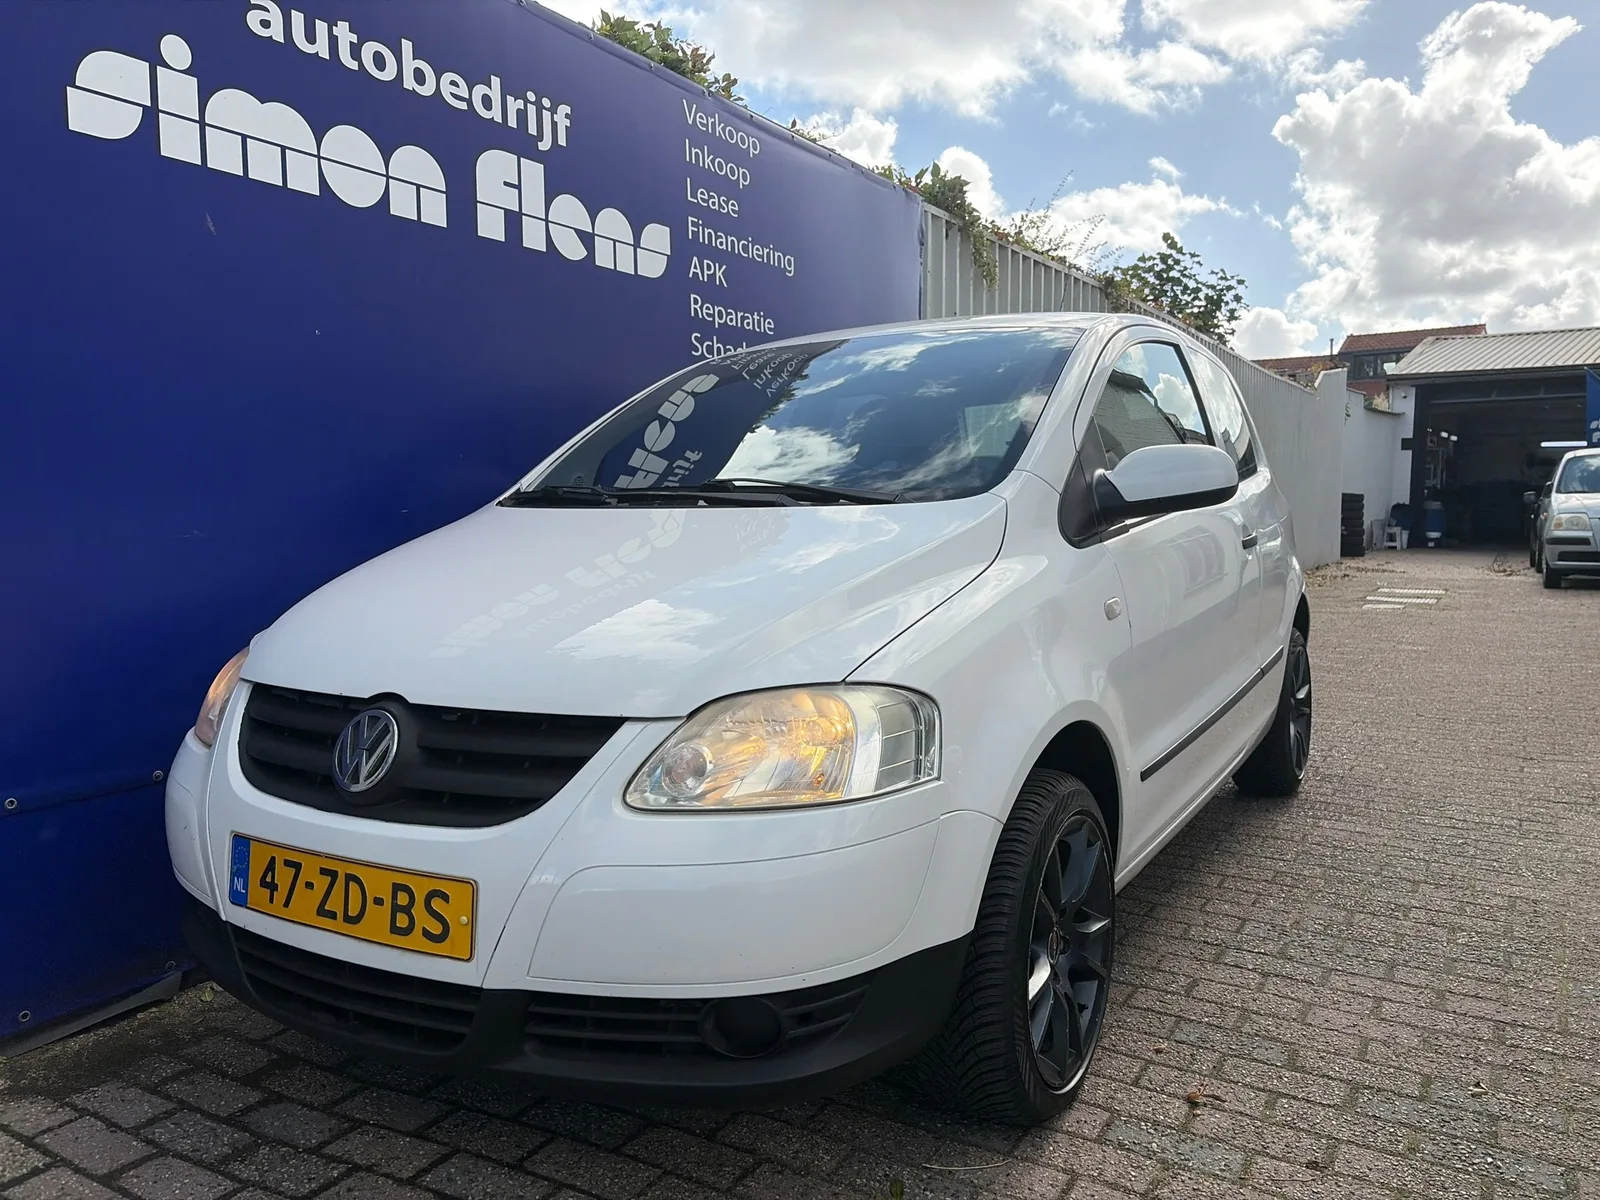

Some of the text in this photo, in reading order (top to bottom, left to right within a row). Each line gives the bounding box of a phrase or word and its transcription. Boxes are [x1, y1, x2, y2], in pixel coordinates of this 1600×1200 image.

[246, 0, 572, 151] autobedrijf
[682, 98, 760, 158] Verkoop
[66, 34, 671, 279] simon flens
[685, 138, 750, 189] Inkoop
[686, 177, 739, 218] Lease
[687, 216, 795, 277] Financiering
[688, 256, 728, 288] APK
[690, 293, 775, 335] Reparatie
[233, 877, 246, 894] NL
[259, 855, 451, 944] 47-ZD-BS
